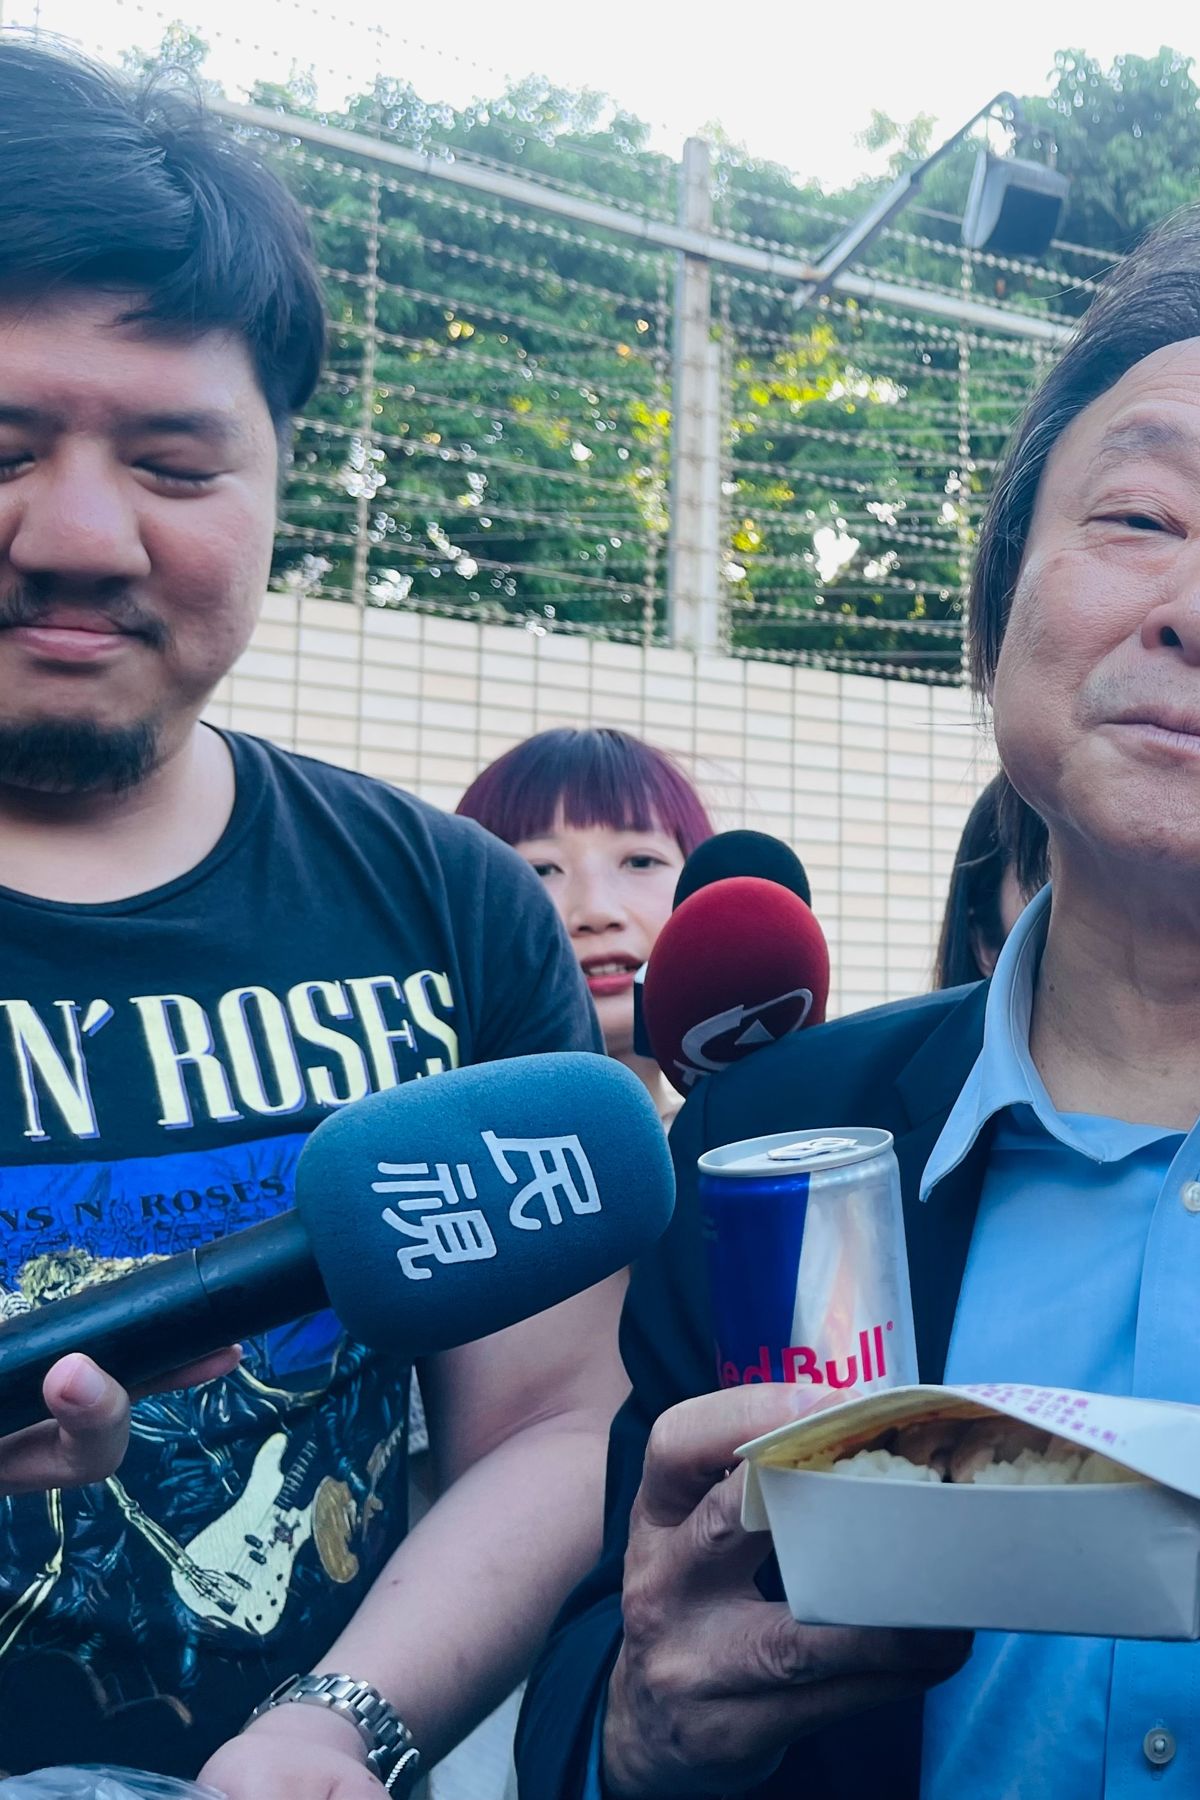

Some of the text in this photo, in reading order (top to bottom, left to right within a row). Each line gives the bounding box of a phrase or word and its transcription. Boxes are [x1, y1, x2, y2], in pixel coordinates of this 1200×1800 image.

[130, 969, 459, 1128] ROSES
[140, 1175, 286, 1219] ROSES
[371, 1130, 602, 1280] 民視
[782, 1326, 886, 1388] Bull
